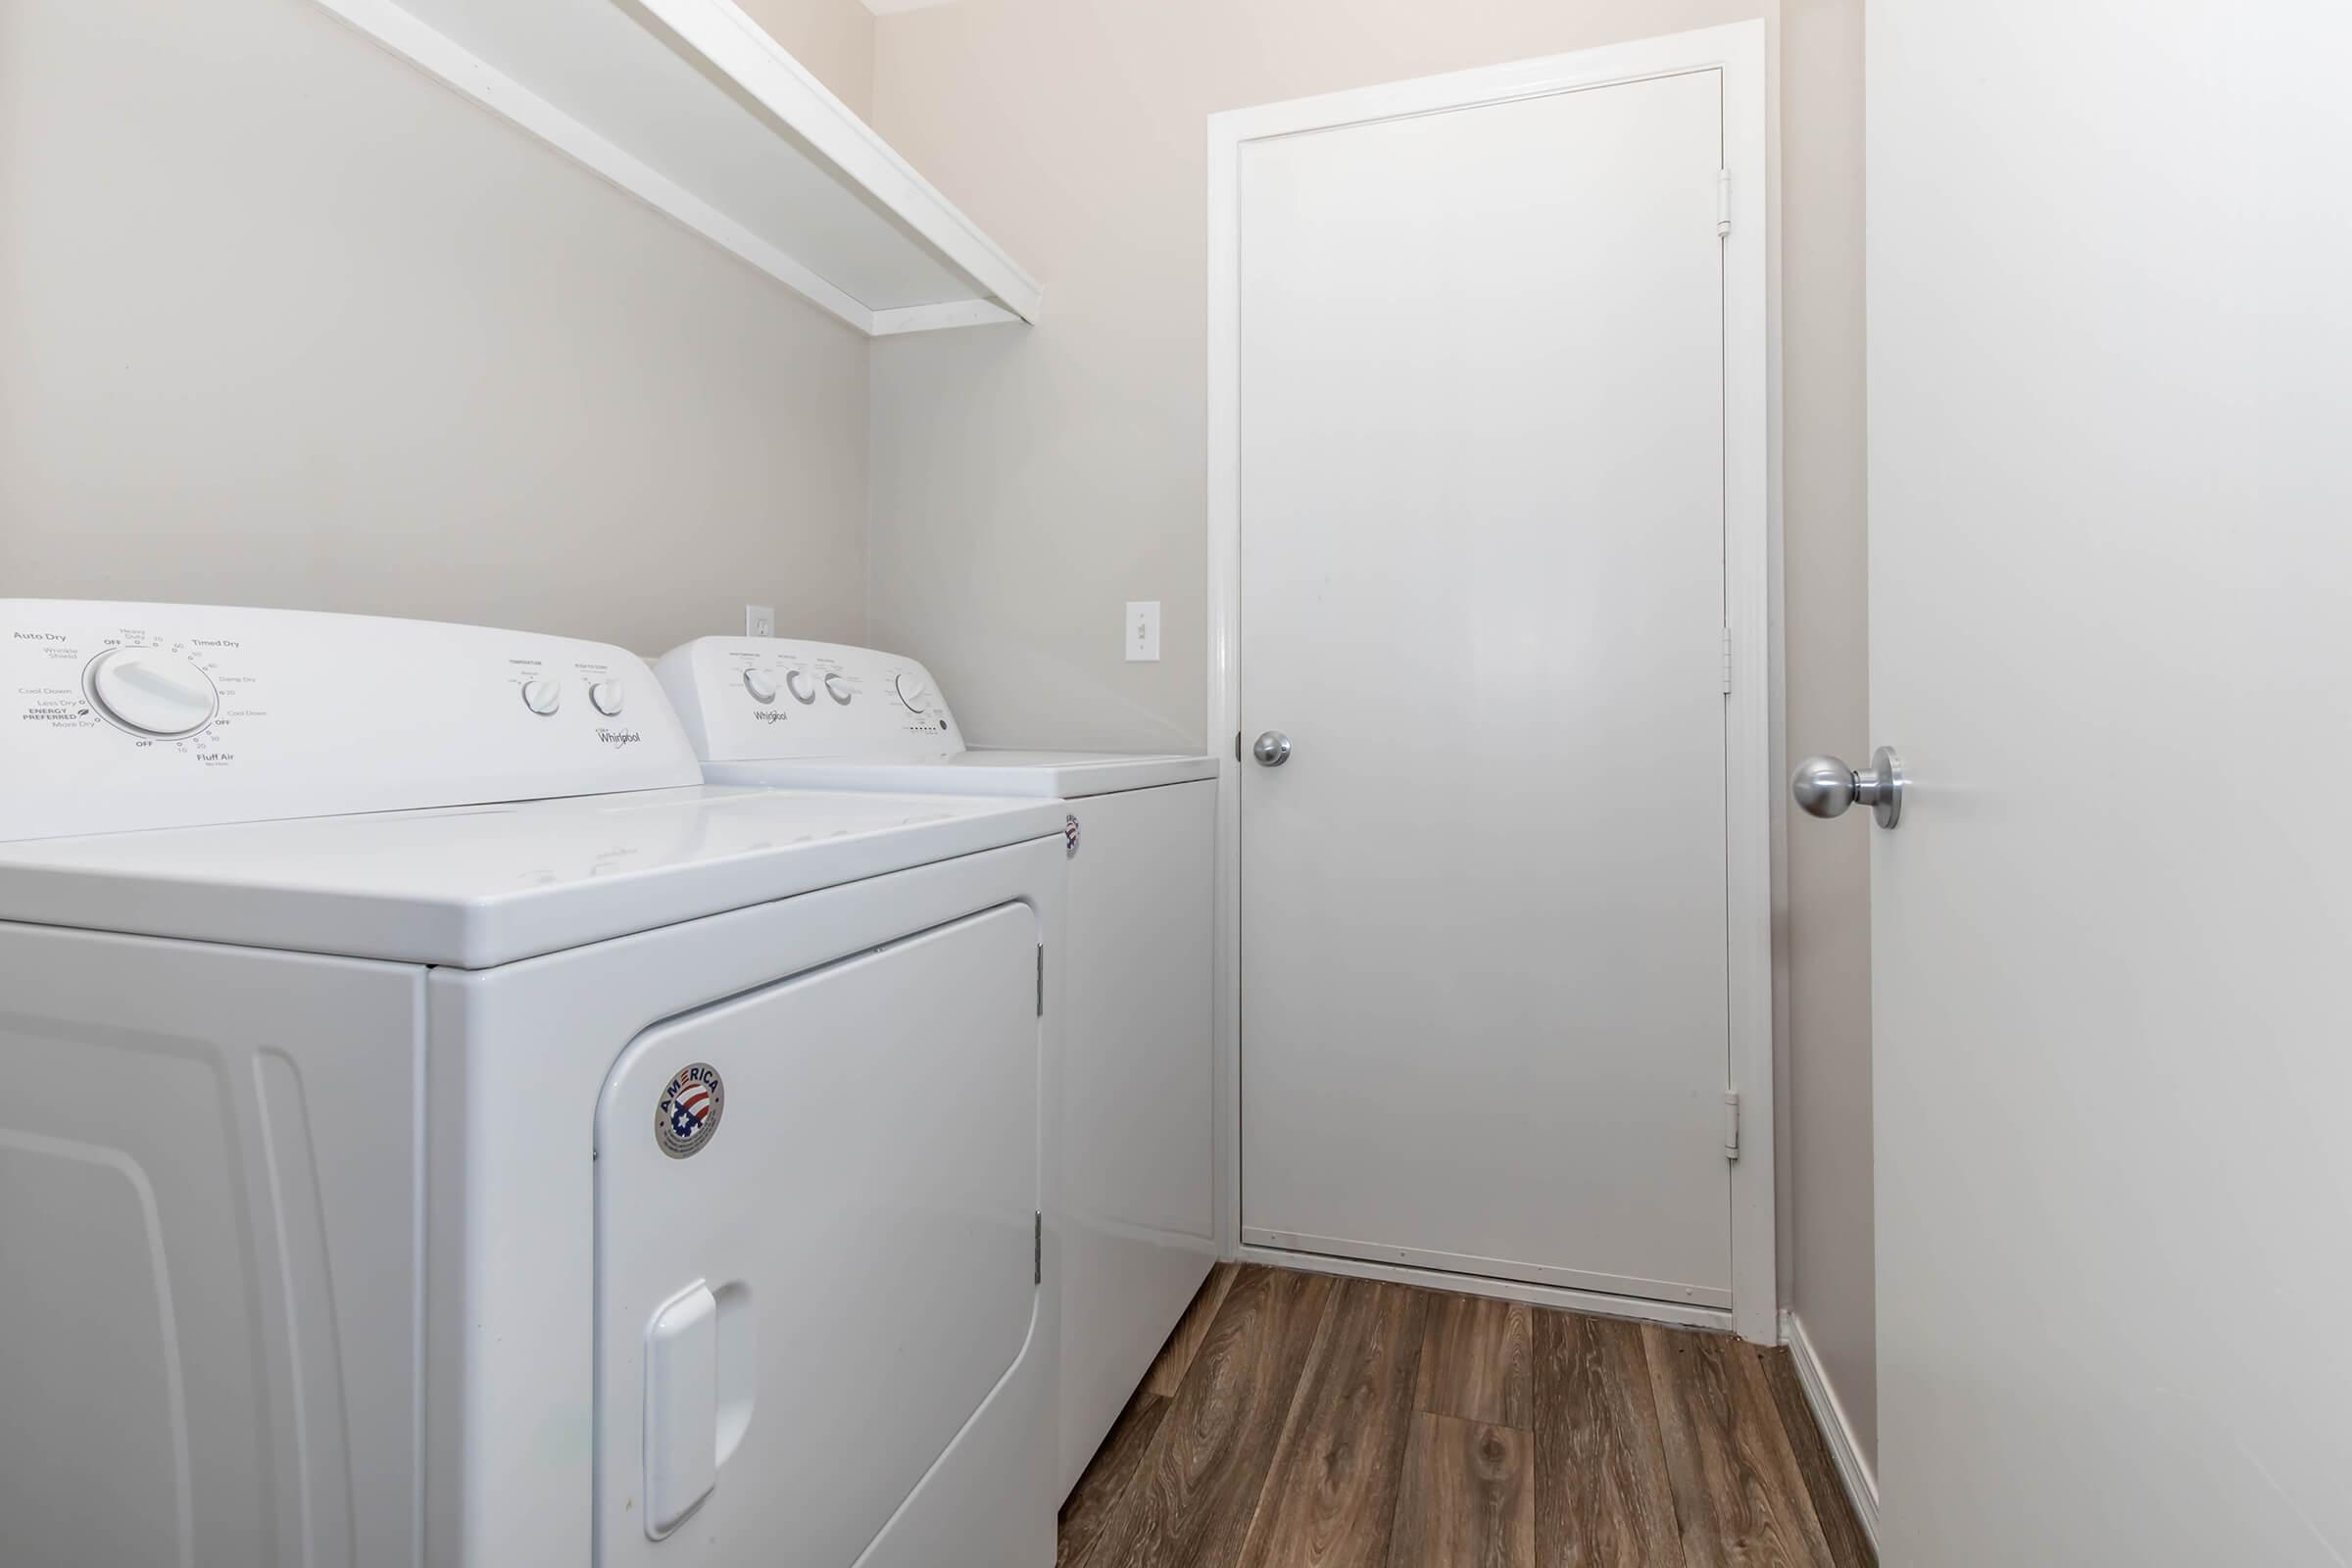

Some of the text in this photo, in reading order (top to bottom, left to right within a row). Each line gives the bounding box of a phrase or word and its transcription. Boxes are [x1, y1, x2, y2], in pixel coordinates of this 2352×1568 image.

[14, 631, 67, 642] Auto Dry
[754, 711, 787, 722] Whirlpool
[598, 729, 641, 747] Whirlpool
[661, 1067, 719, 1113] AMERICA
